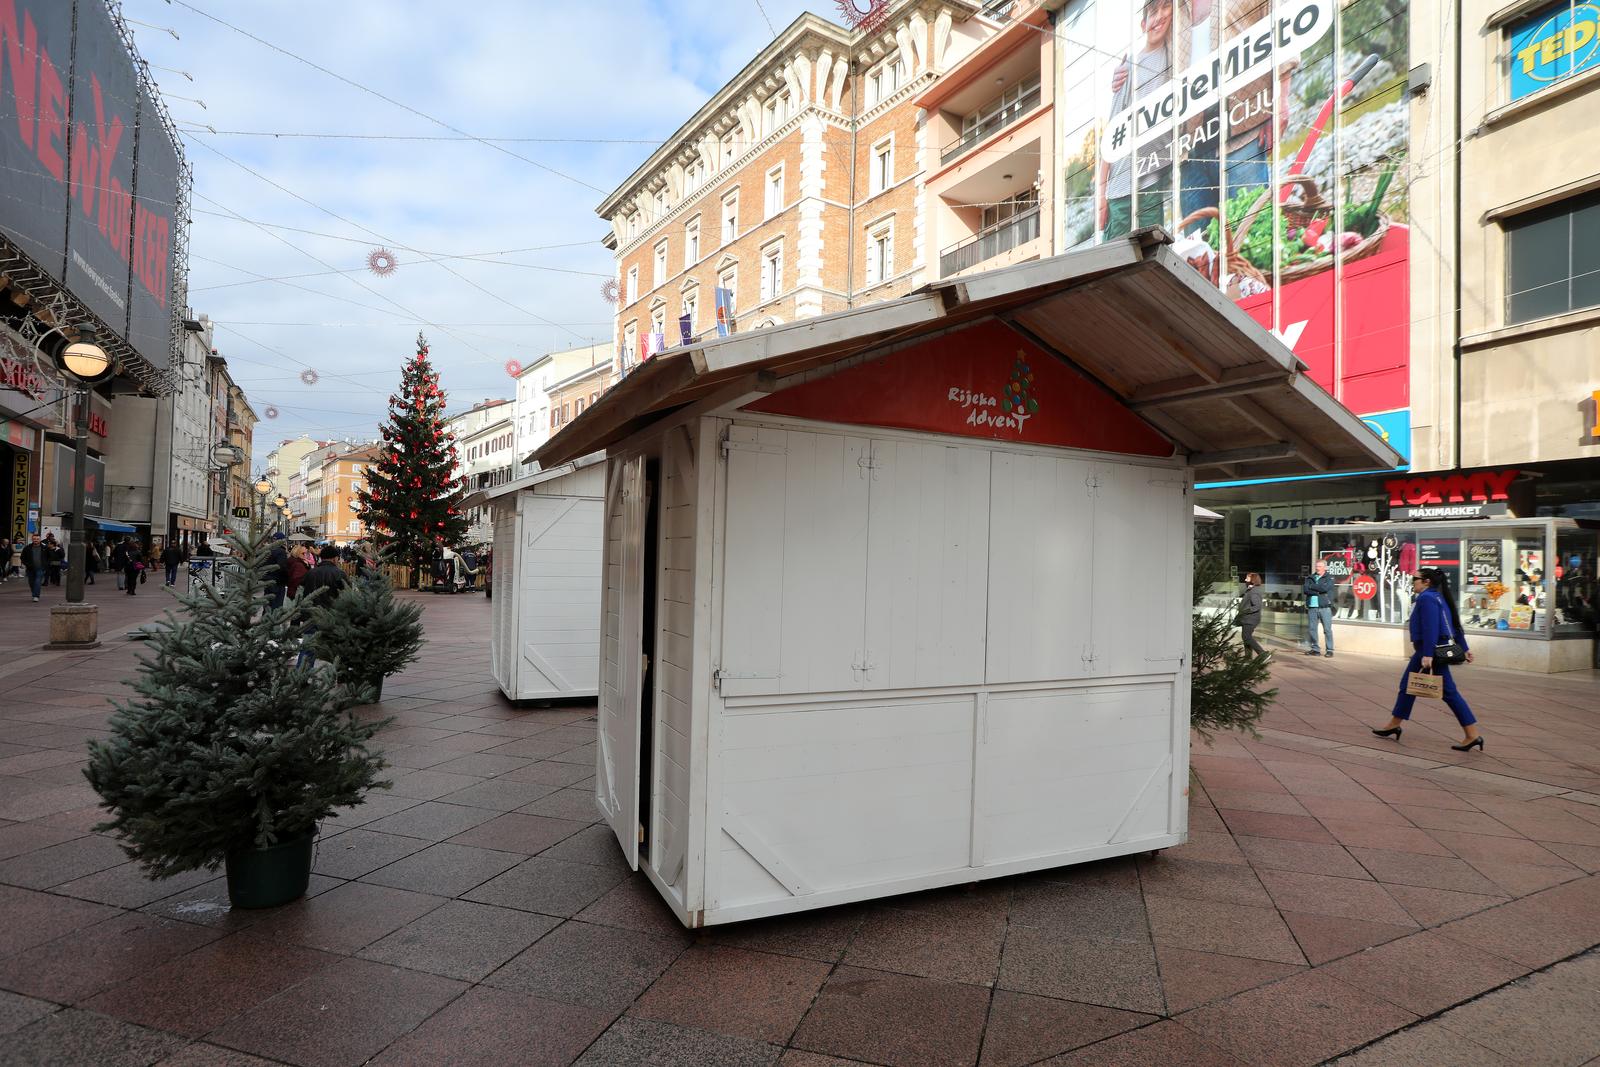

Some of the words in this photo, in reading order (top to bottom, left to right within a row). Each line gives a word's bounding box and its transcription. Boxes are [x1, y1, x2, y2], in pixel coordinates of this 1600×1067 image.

[1517, 14, 1600, 74] TED
[1111, 4, 1320, 150] #TvojeMisto
[1137, 151, 1161, 178] ZA
[90, 70, 169, 311] YORKER
[948, 386, 996, 408] Rijeka
[16, 454, 27, 494] OTKUP
[1385, 469, 1520, 506] TOMMY
[14, 499, 25, 539] ZLATA
[1408, 506, 1482, 517] MAXIMARKET
[1327, 567, 1352, 576] RIDAY
[1467, 563, 1501, 576] -50%
